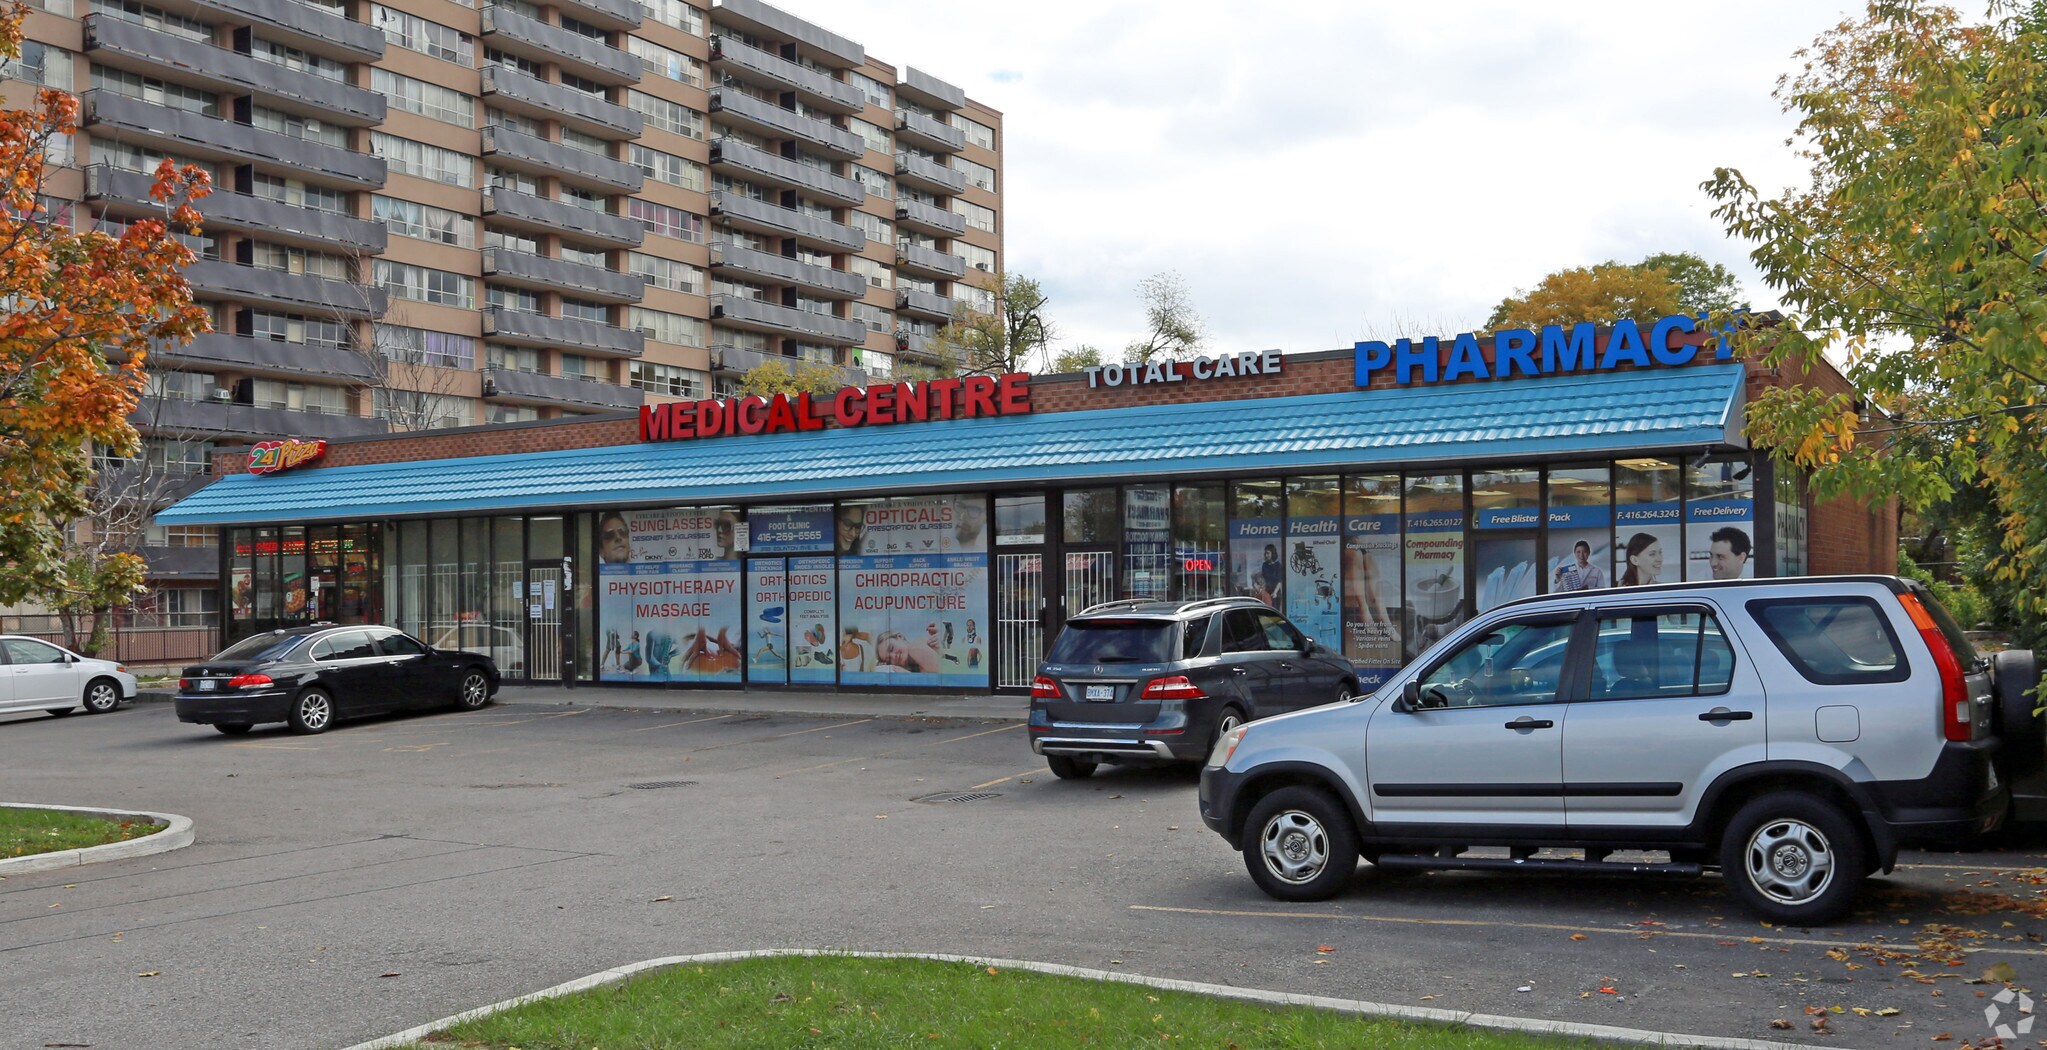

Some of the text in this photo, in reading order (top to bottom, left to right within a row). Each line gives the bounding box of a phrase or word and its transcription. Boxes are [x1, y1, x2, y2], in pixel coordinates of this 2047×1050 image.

[1354, 308, 1750, 387] PHARMACY
[1084, 350, 1282, 388] TOTAL CARE
[640, 372, 1031, 441] MEDICAL CENTRE
[250, 440, 319, 470] 241 Pizza
[865, 507, 952, 524] OPTICALS
[1511, 514, 1538, 522] Blister
[1549, 513, 1571, 522] Pack
[1626, 510, 1680, 519] 416.264.3243
[1694, 506, 1748, 517] Free Delivery
[630, 517, 712, 532] SUNGLASSES
[1240, 520, 1381, 535] Home Health Care
[1414, 518, 1462, 527] 416.265.0127
[757, 531, 822, 541] 416-269-6565
[1406, 539, 1464, 550] Compounding
[1414, 551, 1455, 560] Pharmacy
[1185, 559, 1212, 571] OPEN
[760, 575, 827, 586] ORTHOTICS
[855, 572, 965, 587] CHIROPRACTIC
[609, 580, 735, 595] PHYSIOTHERAPY
[756, 591, 832, 602] ORTHOPEDIC
[854, 595, 966, 610] ACUPUNCTURE
[636, 603, 711, 618] MASSAGE
